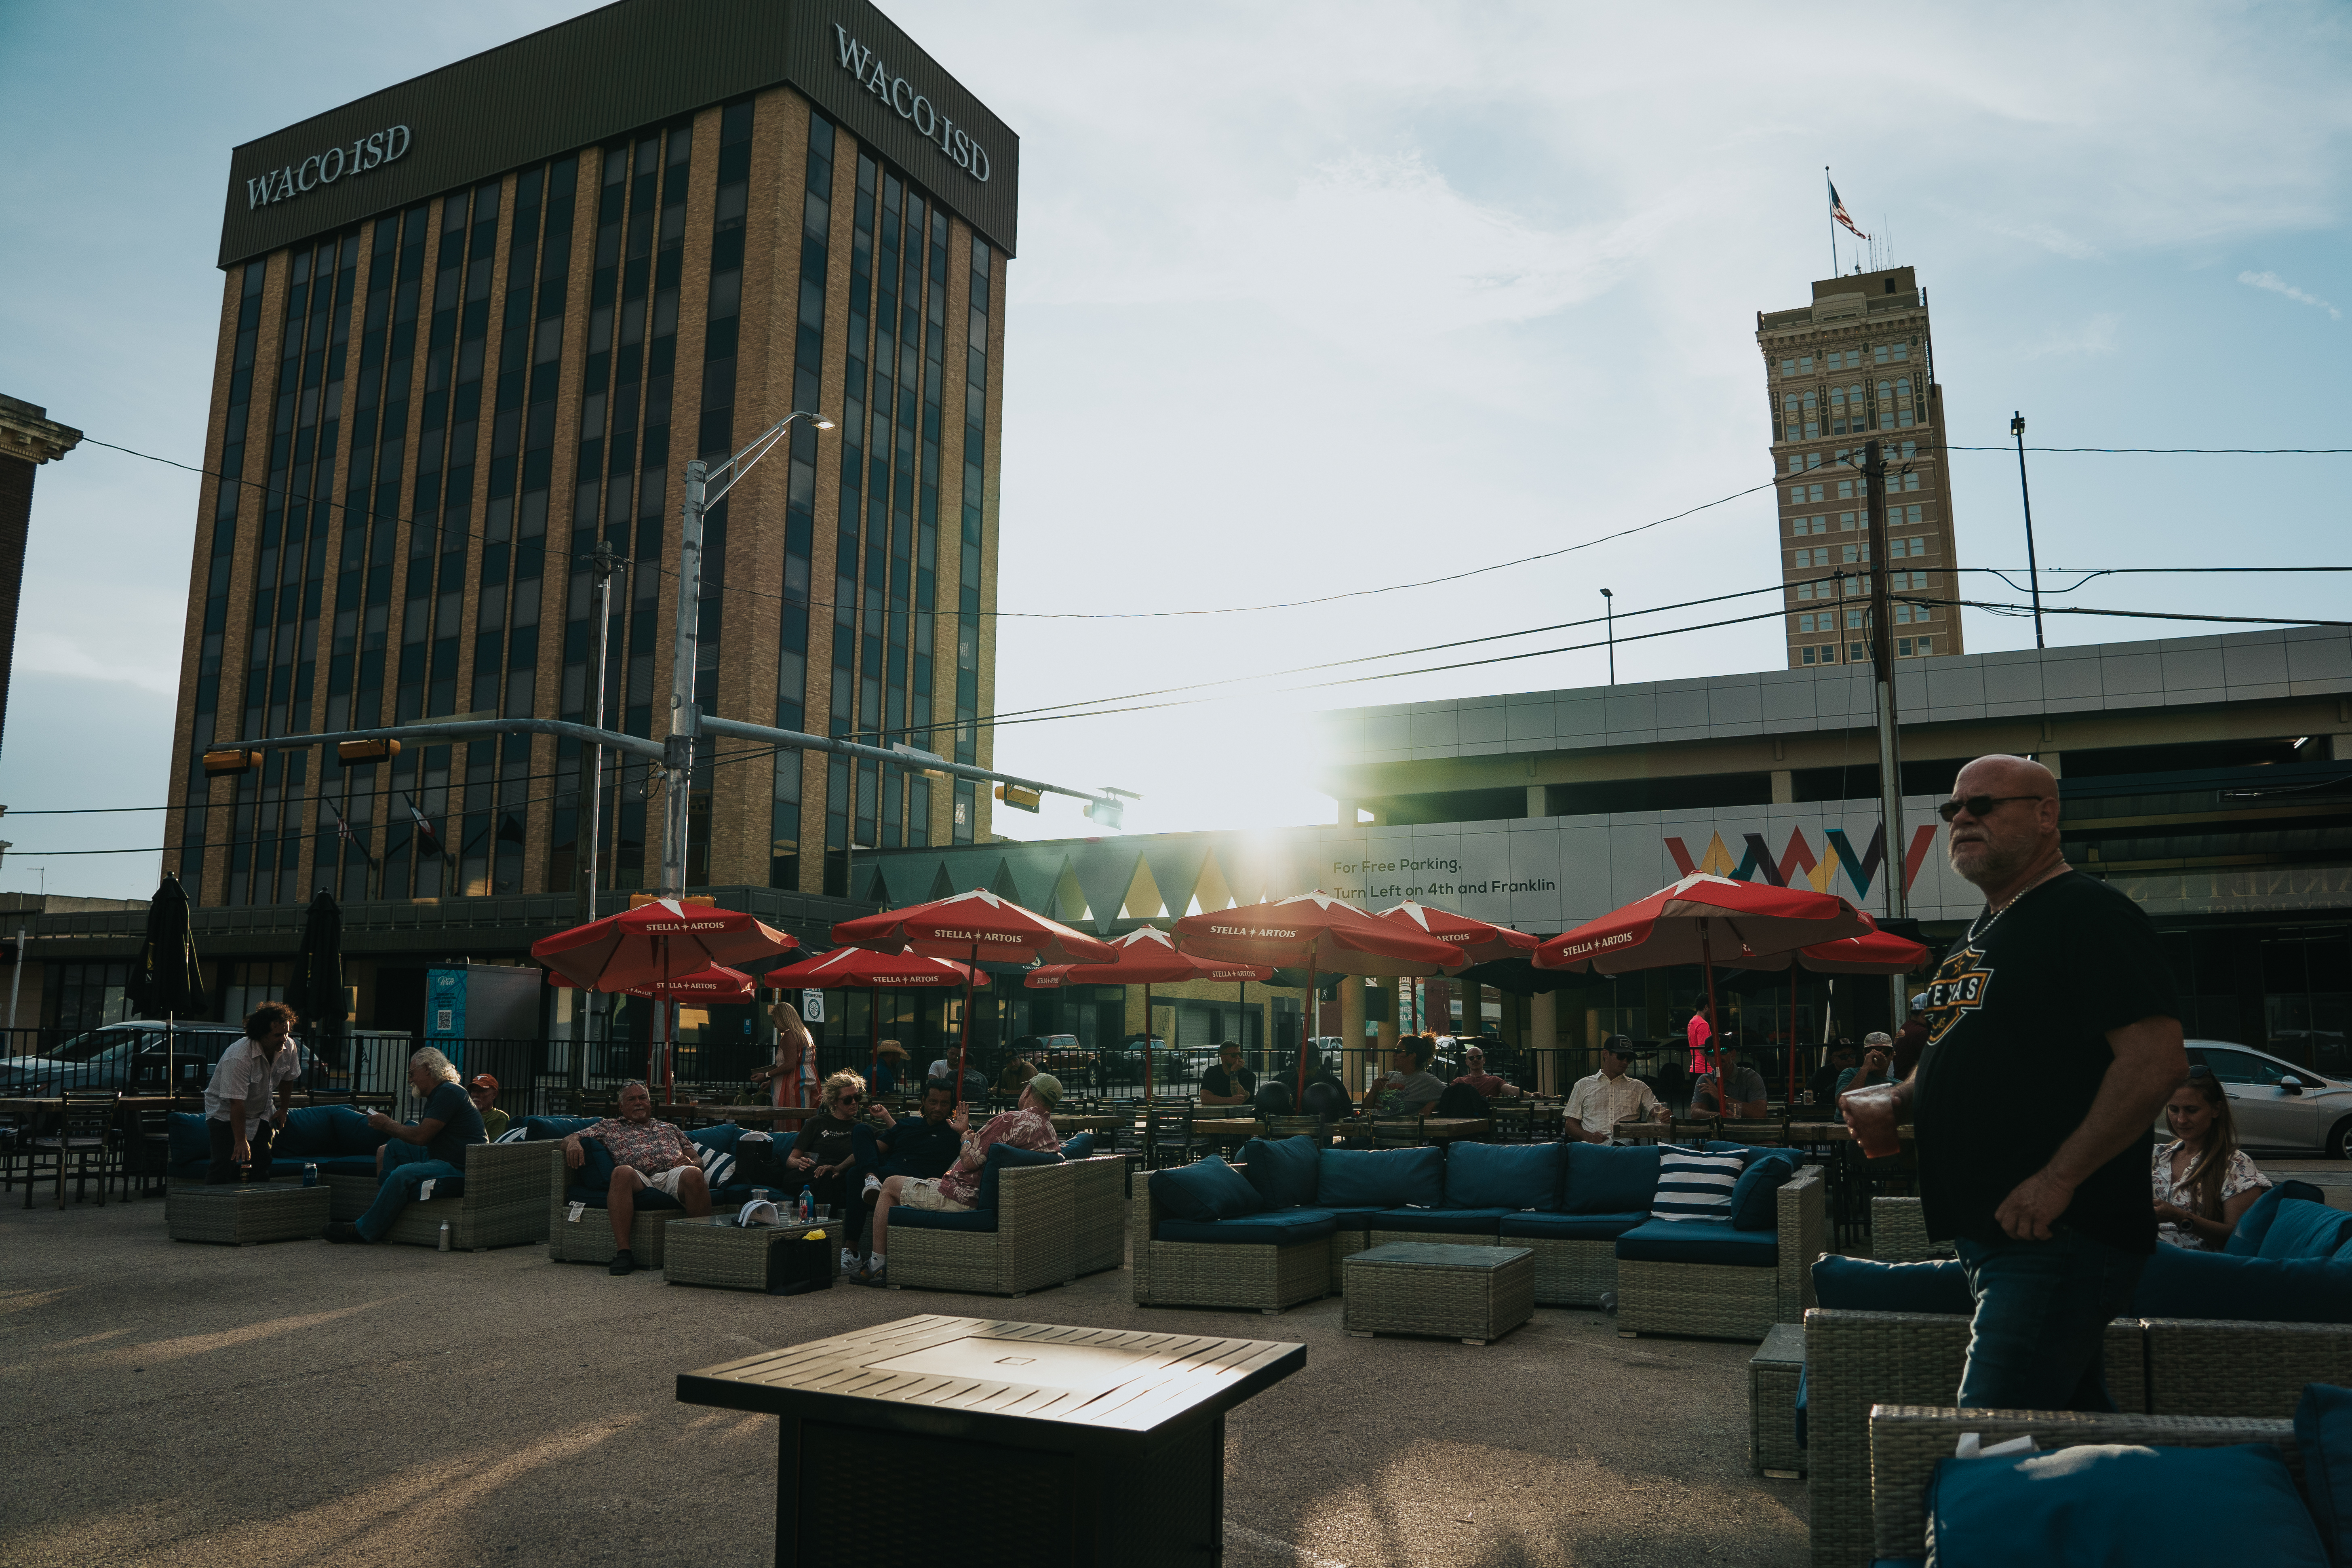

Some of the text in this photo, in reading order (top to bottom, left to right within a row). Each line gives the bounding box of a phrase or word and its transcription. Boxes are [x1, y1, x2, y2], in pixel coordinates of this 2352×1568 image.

[835, 23, 990, 182] WACO ISD
[247, 125, 412, 210] WACO ISD
[1334, 857, 1462, 874] For Free Parking,
[1334, 879, 1555, 899] Turn Left on 4th and Franklin
[935, 929, 1022, 943] STELLA ARTOIS
[1210, 925, 1297, 938] STELLA ARTOIS
[1437, 933, 1470, 942] ARTOIS
[1563, 932, 1632, 957] STELLA ARTOIS
[438, 976, 455, 986] Waco
